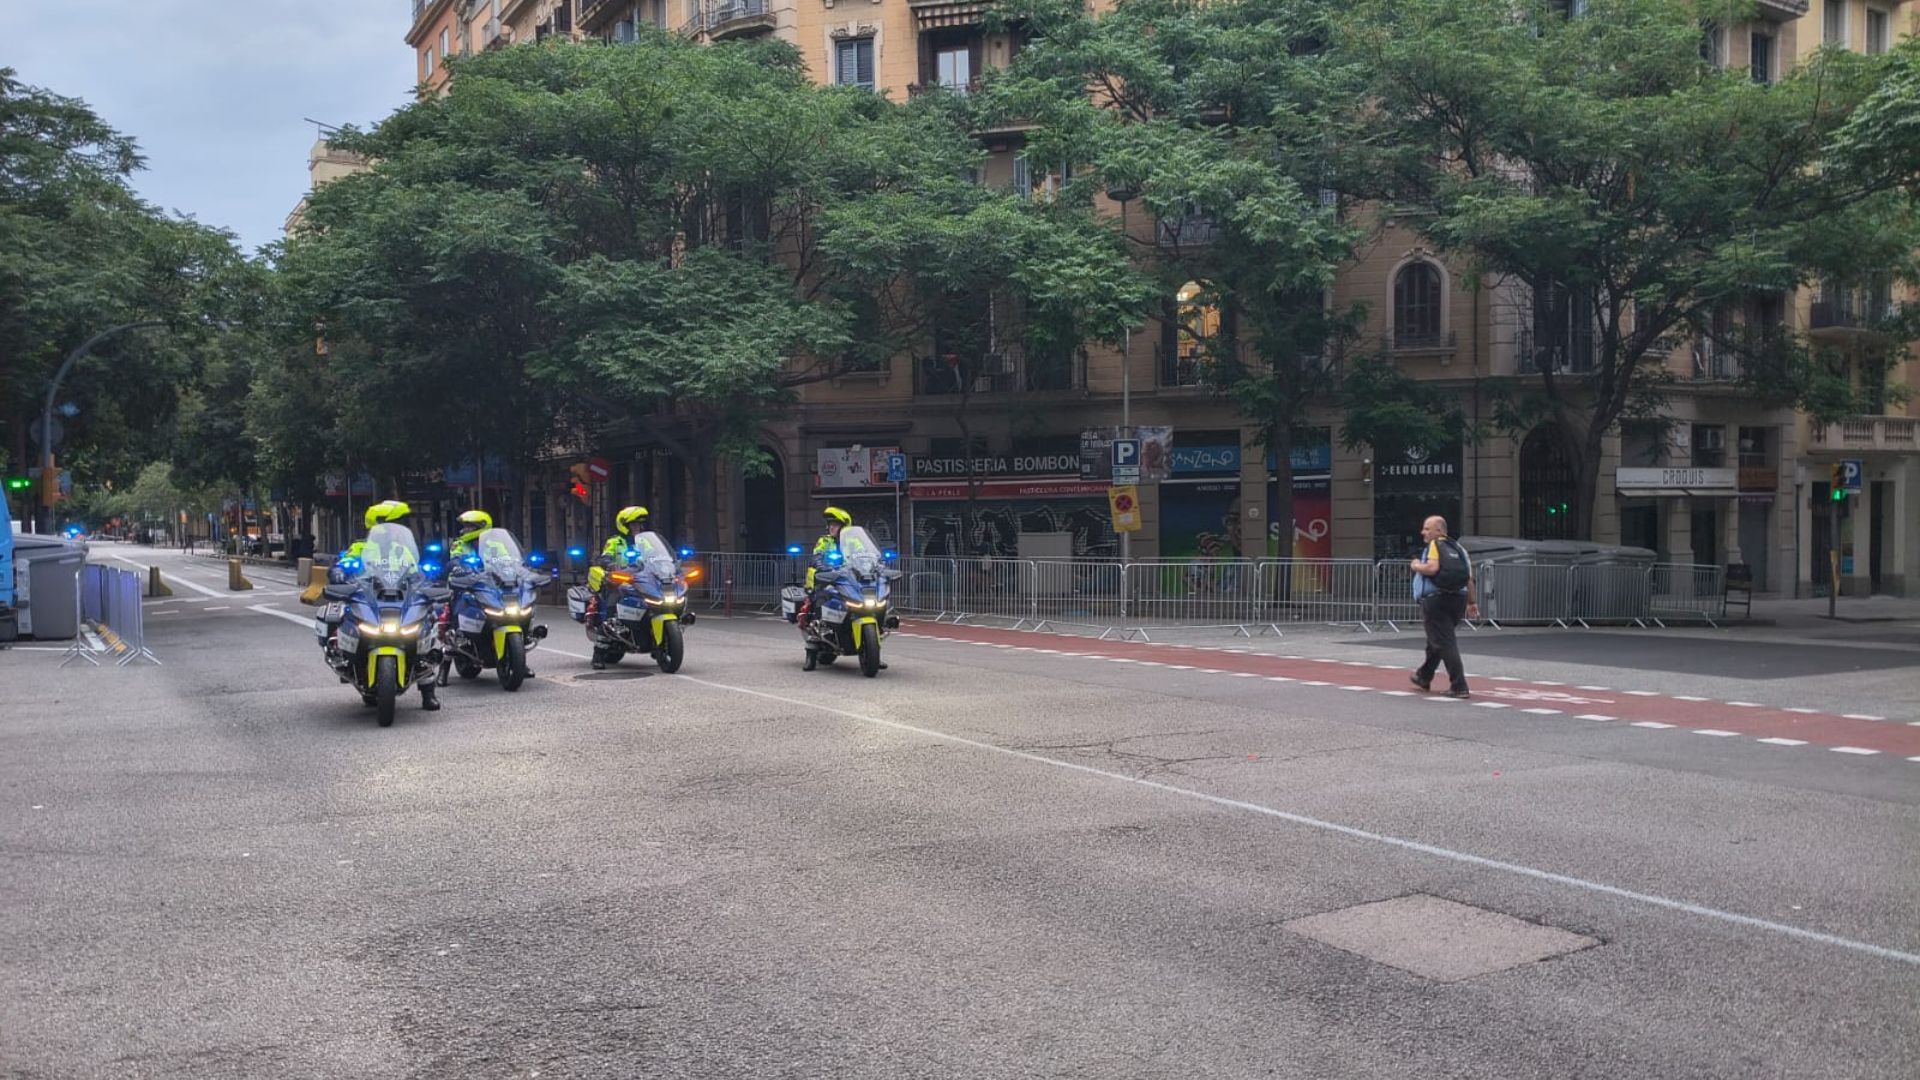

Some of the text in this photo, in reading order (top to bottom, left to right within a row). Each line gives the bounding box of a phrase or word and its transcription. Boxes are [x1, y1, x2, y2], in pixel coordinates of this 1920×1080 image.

[1117, 443, 1134, 464] P
[892, 457, 902, 470] P
[1013, 455, 1080, 471] BOMBON
[1662, 470, 1705, 485] CROQUIS
[1844, 462, 1858, 484] P
